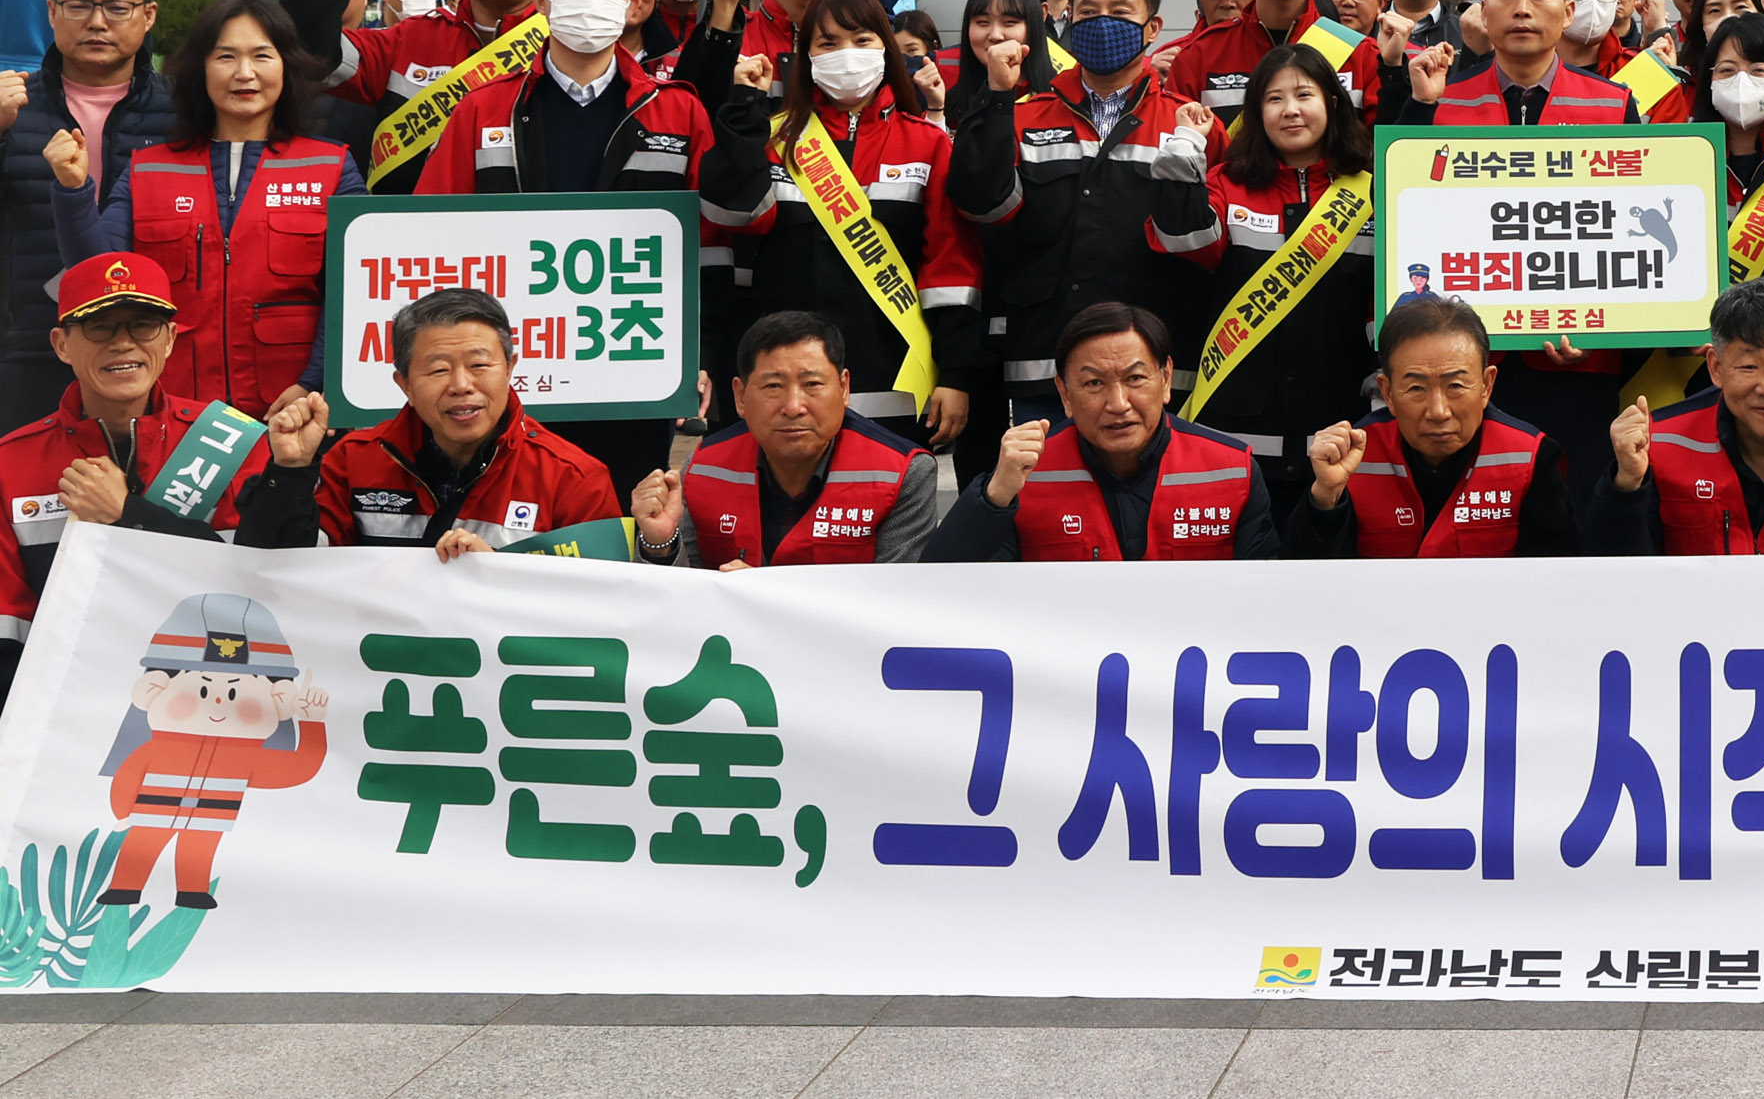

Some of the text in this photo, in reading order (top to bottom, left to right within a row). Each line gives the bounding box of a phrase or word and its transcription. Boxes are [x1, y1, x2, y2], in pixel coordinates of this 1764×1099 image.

[394, 100, 442, 148] 하산시
[371, 132, 401, 170] 산불
[1452, 150, 1537, 179] 실수로
[1546, 150, 1574, 178] 낸
[266, 181, 323, 195] 산불예방
[281, 195, 322, 207] 전라남도
[794, 137, 917, 314] 산불방지 모두 함께
[1321, 187, 1366, 234] 입산시
[1490, 200, 1617, 242] 엄연한
[360, 234, 663, 302] 가꾸는데 30년
[1276, 223, 1338, 288] 산불조심
[1441, 249, 1664, 292] 범죄입니다!
[1236, 273, 1290, 330] 하산시
[1502, 308, 1606, 331] 산불조심
[575, 299, 665, 362] 3초
[200, 420, 244, 455] 그
[163, 456, 222, 517] 시작
[815, 505, 875, 521] 산불예방
[829, 523, 874, 538] 전라남도
[1173, 506, 1232, 521] 산불예방
[1190, 523, 1231, 537] 전라남도
[1470, 506, 1513, 522] 전라남도
[357, 632, 828, 888] 푸른숲,
[872, 645, 1018, 868] 그
[1057, 642, 1519, 881] 사랑의
[1329, 946, 1563, 990] 전라남도
